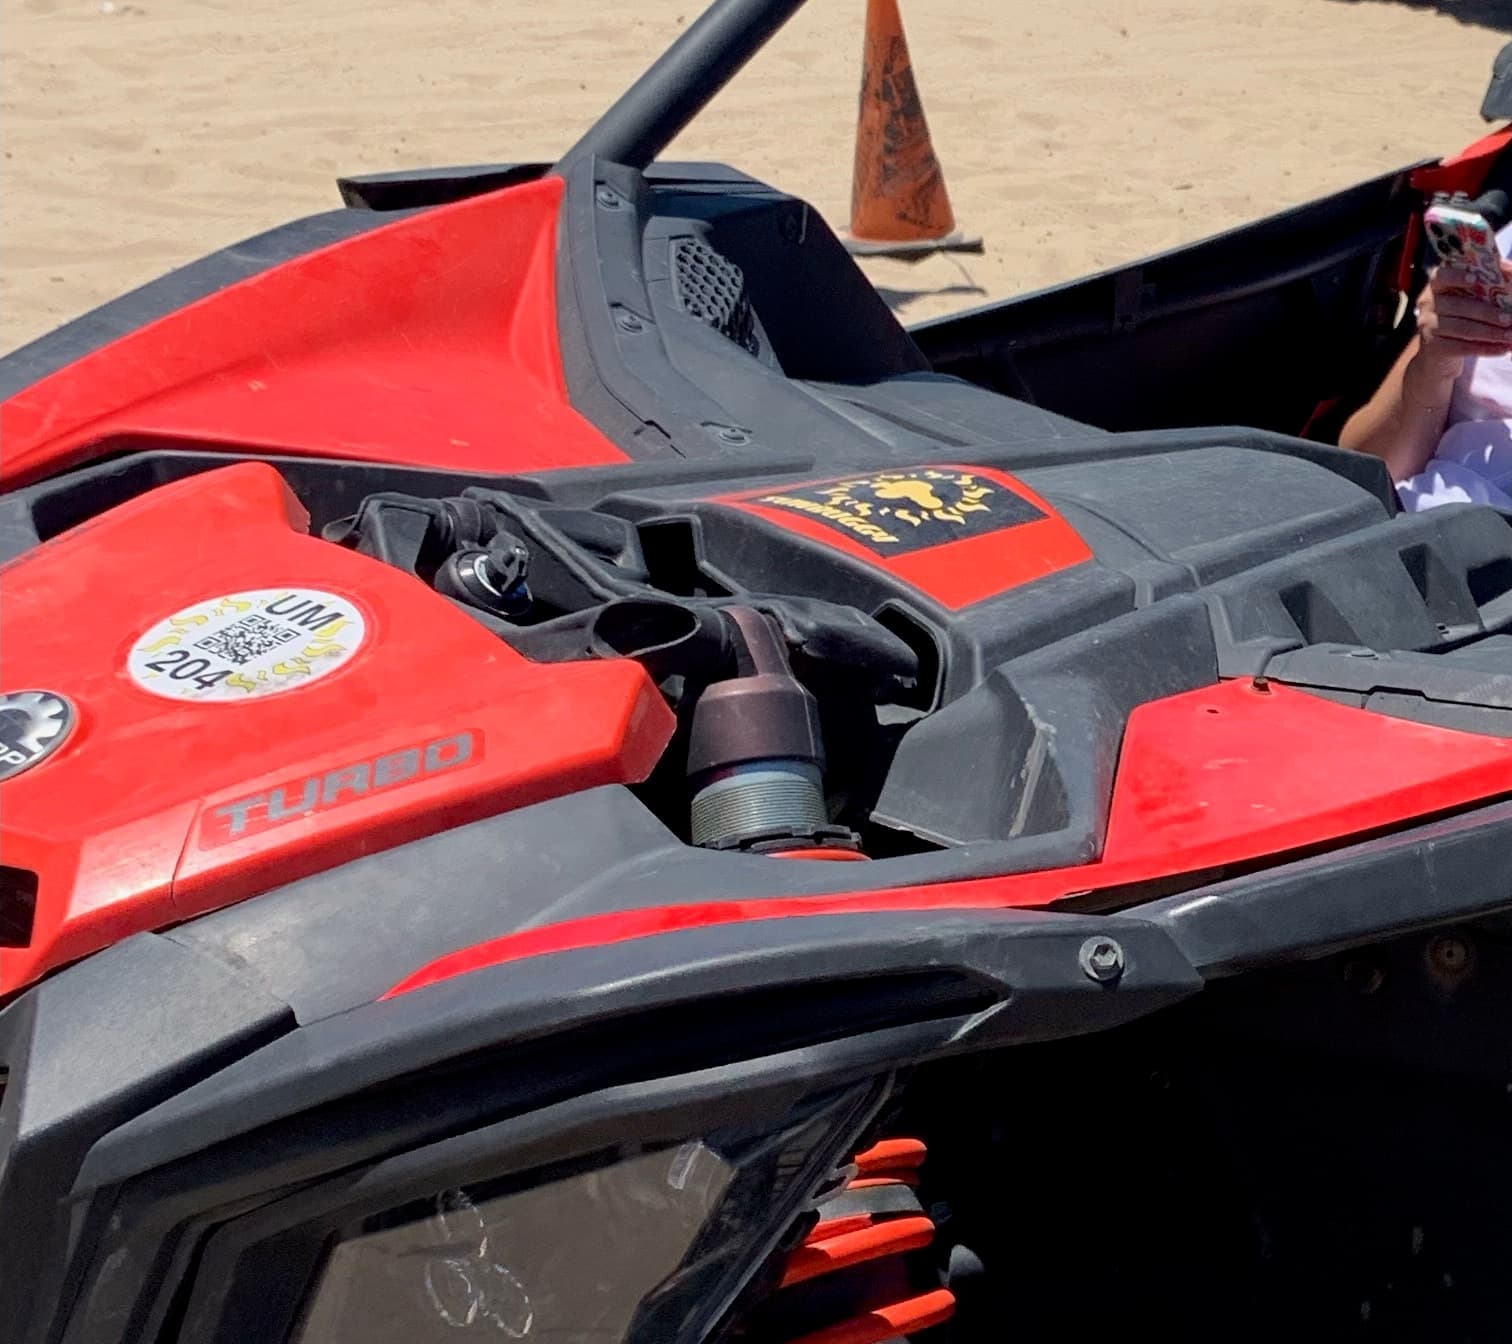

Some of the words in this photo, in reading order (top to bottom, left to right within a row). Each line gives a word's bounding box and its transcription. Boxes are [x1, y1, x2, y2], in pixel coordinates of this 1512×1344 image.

[760, 495, 900, 542] SUNBUGGY
[265, 594, 344, 631] UM
[144, 650, 235, 690] 204
[215, 732, 474, 836] TURBO
